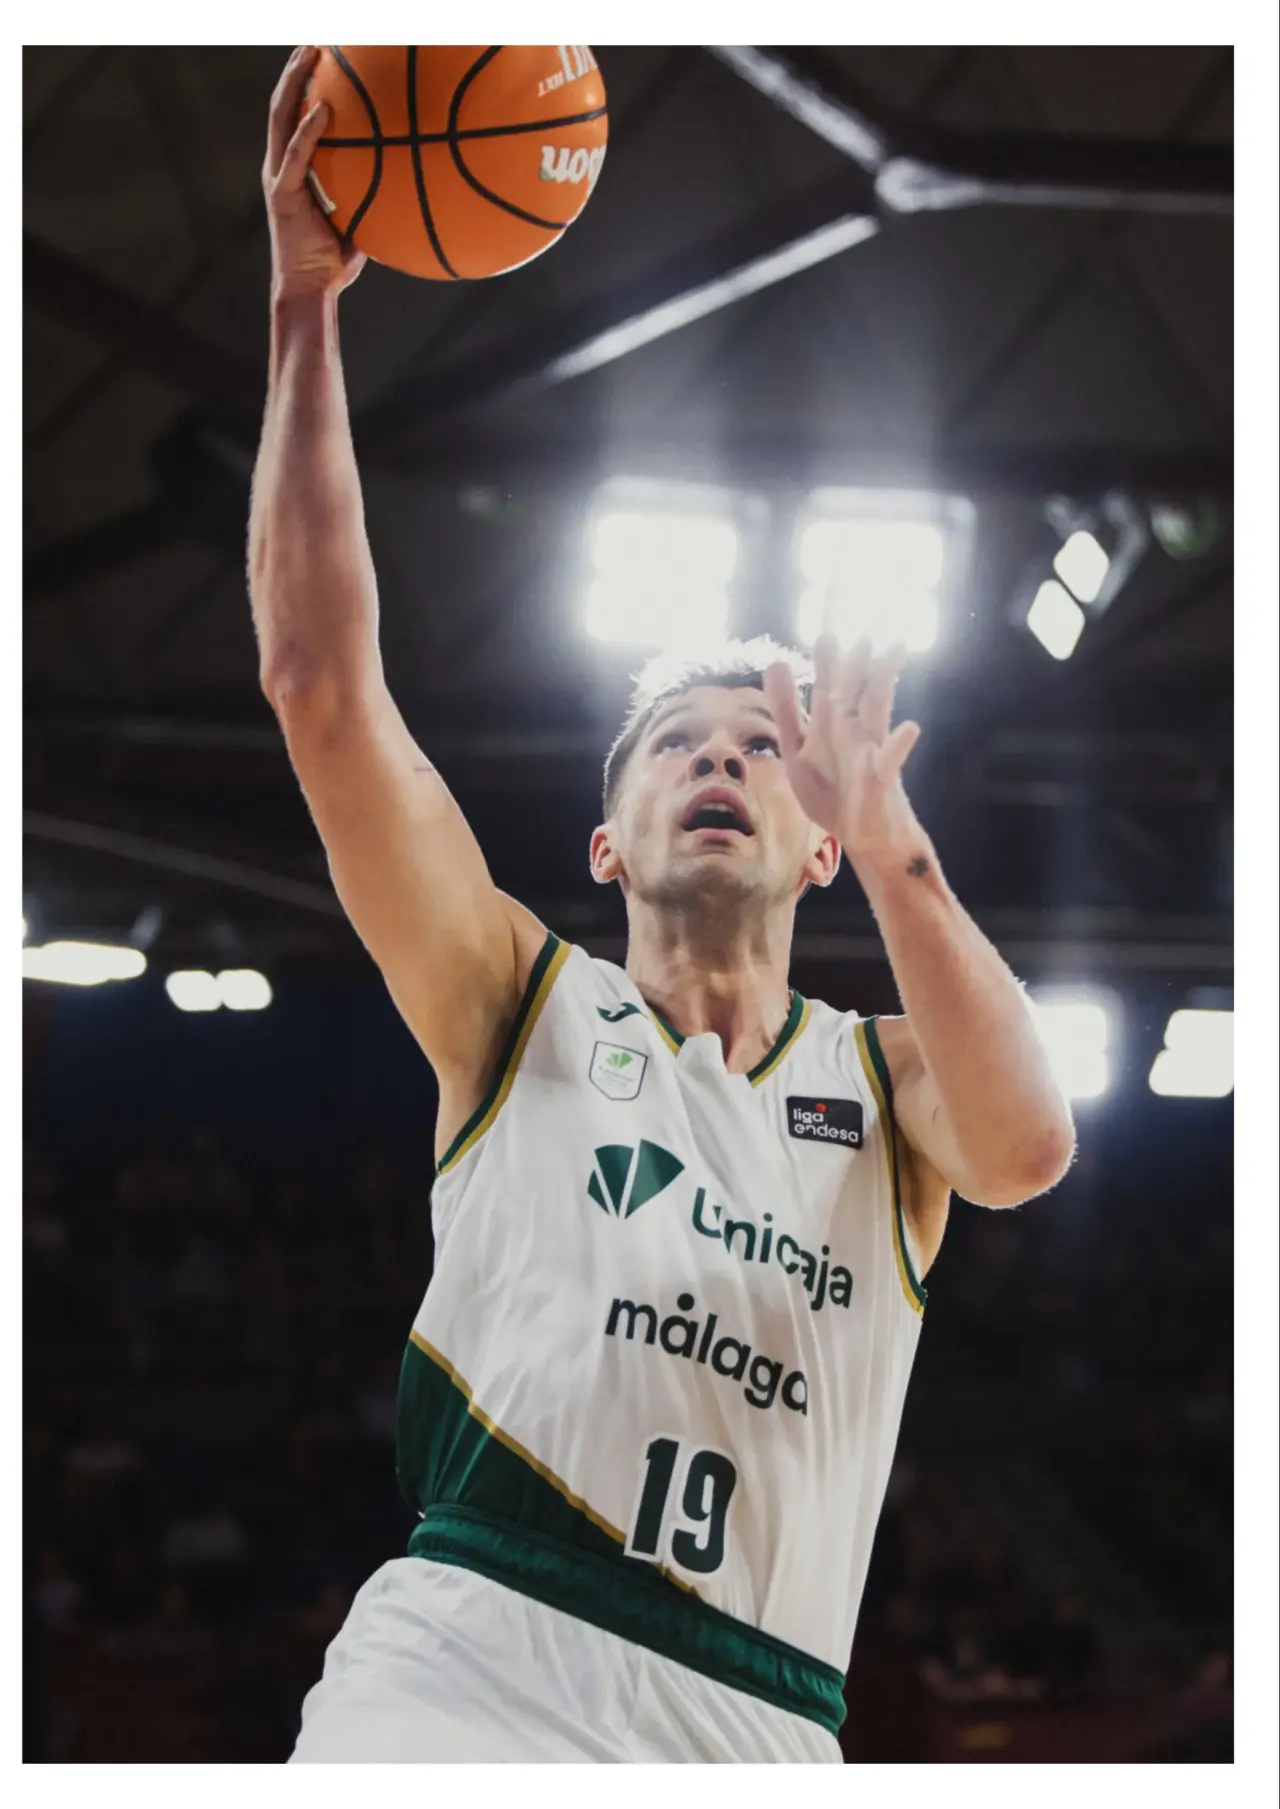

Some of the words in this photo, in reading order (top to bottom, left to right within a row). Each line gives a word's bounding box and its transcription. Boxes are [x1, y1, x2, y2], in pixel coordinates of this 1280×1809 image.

[793, 1107, 824, 1124] liga
[794, 1123, 859, 1143] endesa
[631, 1437, 737, 1574] 19
